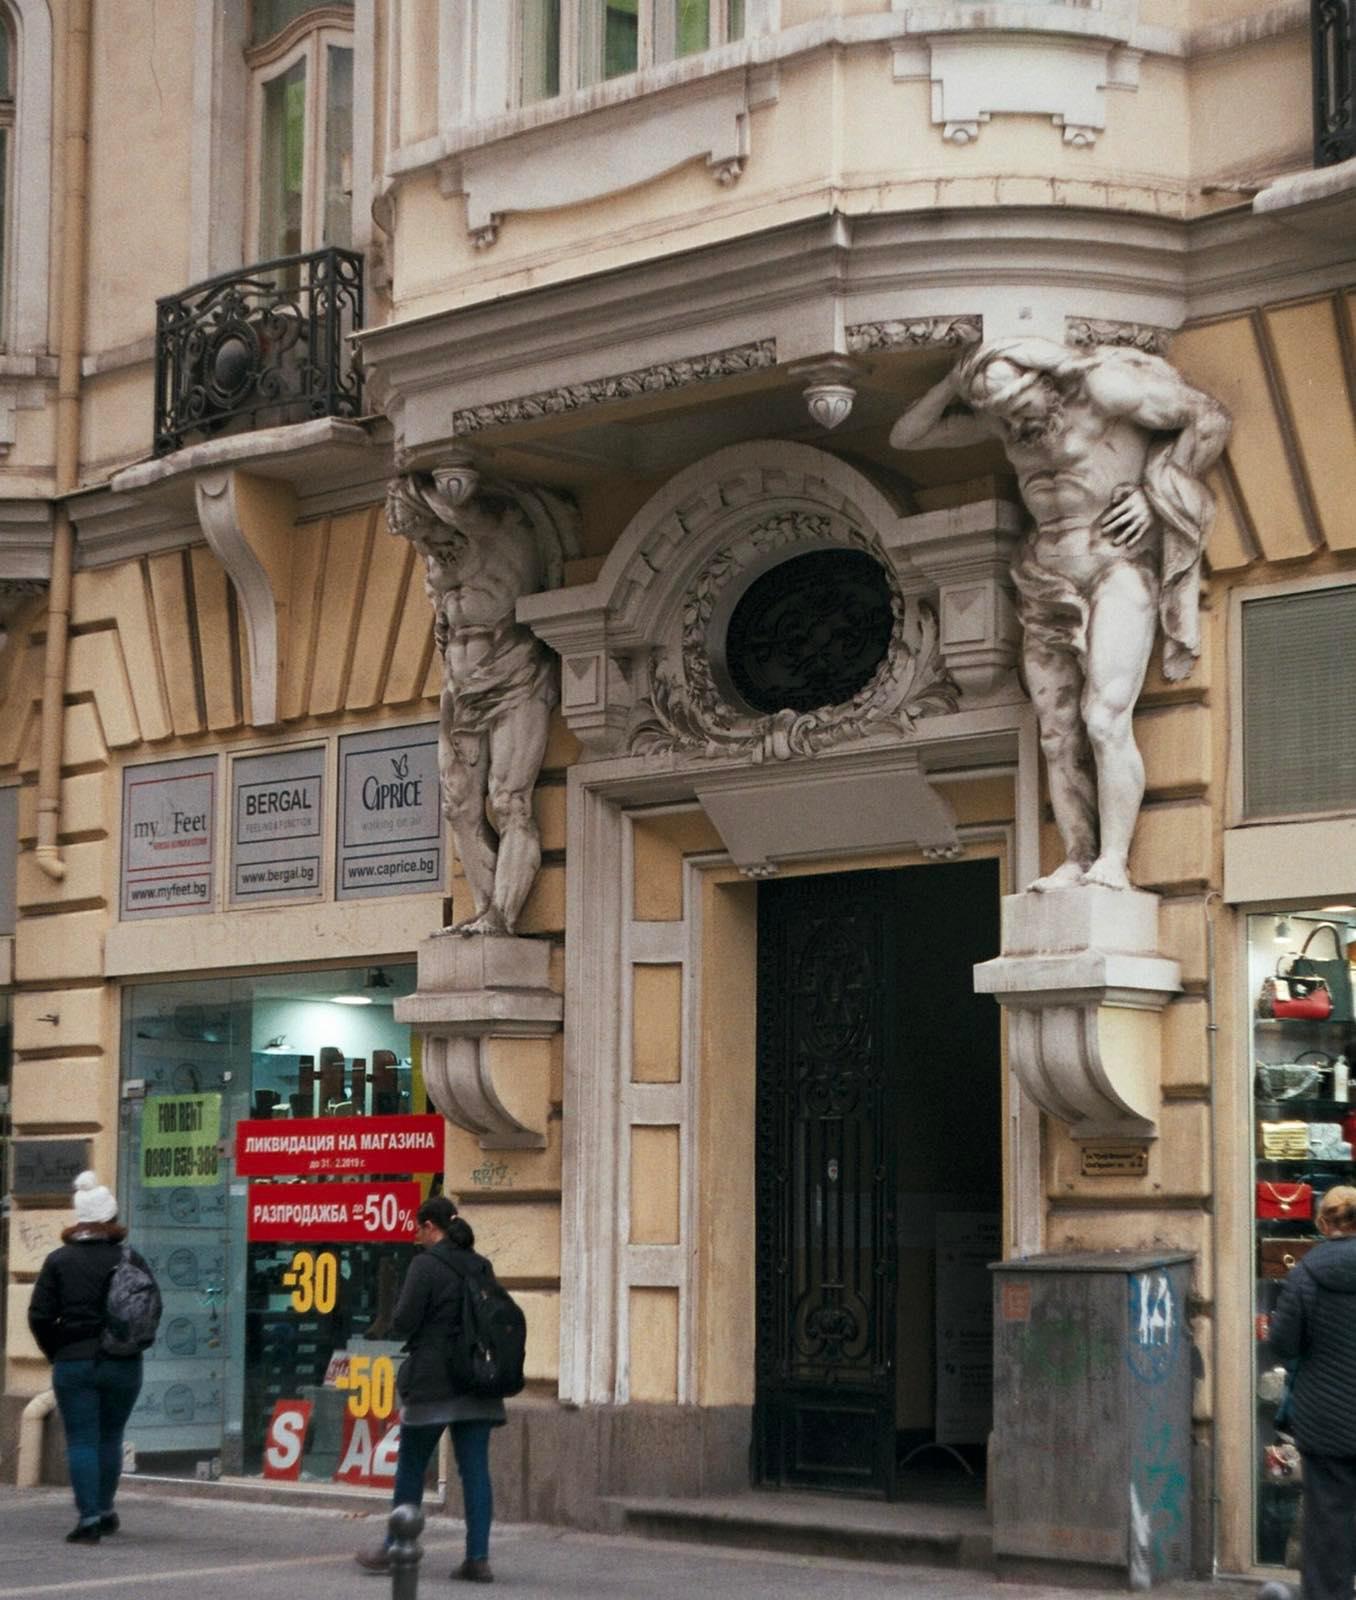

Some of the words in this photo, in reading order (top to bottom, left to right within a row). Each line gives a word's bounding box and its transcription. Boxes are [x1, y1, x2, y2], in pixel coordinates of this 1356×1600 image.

[246, 788, 312, 815] BERGAL
[134, 820, 159, 844] my
[171, 811, 207, 834] Feet
[241, 865, 314, 883] www.bergal.bg
[348, 857, 434, 878] www.caprice.bg
[131, 881, 207, 900] www.myfeet.bg
[158, 1102, 177, 1133] FOR
[244, 1134, 335, 1155] ЛИКВИДАЦИЯ
[338, 1134, 357, 1151] НА
[360, 1132, 435, 1150] МАГАЗИНА
[309, 1160, 319, 1169] до
[253, 1203, 348, 1226] РАЗПРОДАЖБА
[282, 1250, 337, 1314] -30
[336, 1355, 394, 1419] -50
